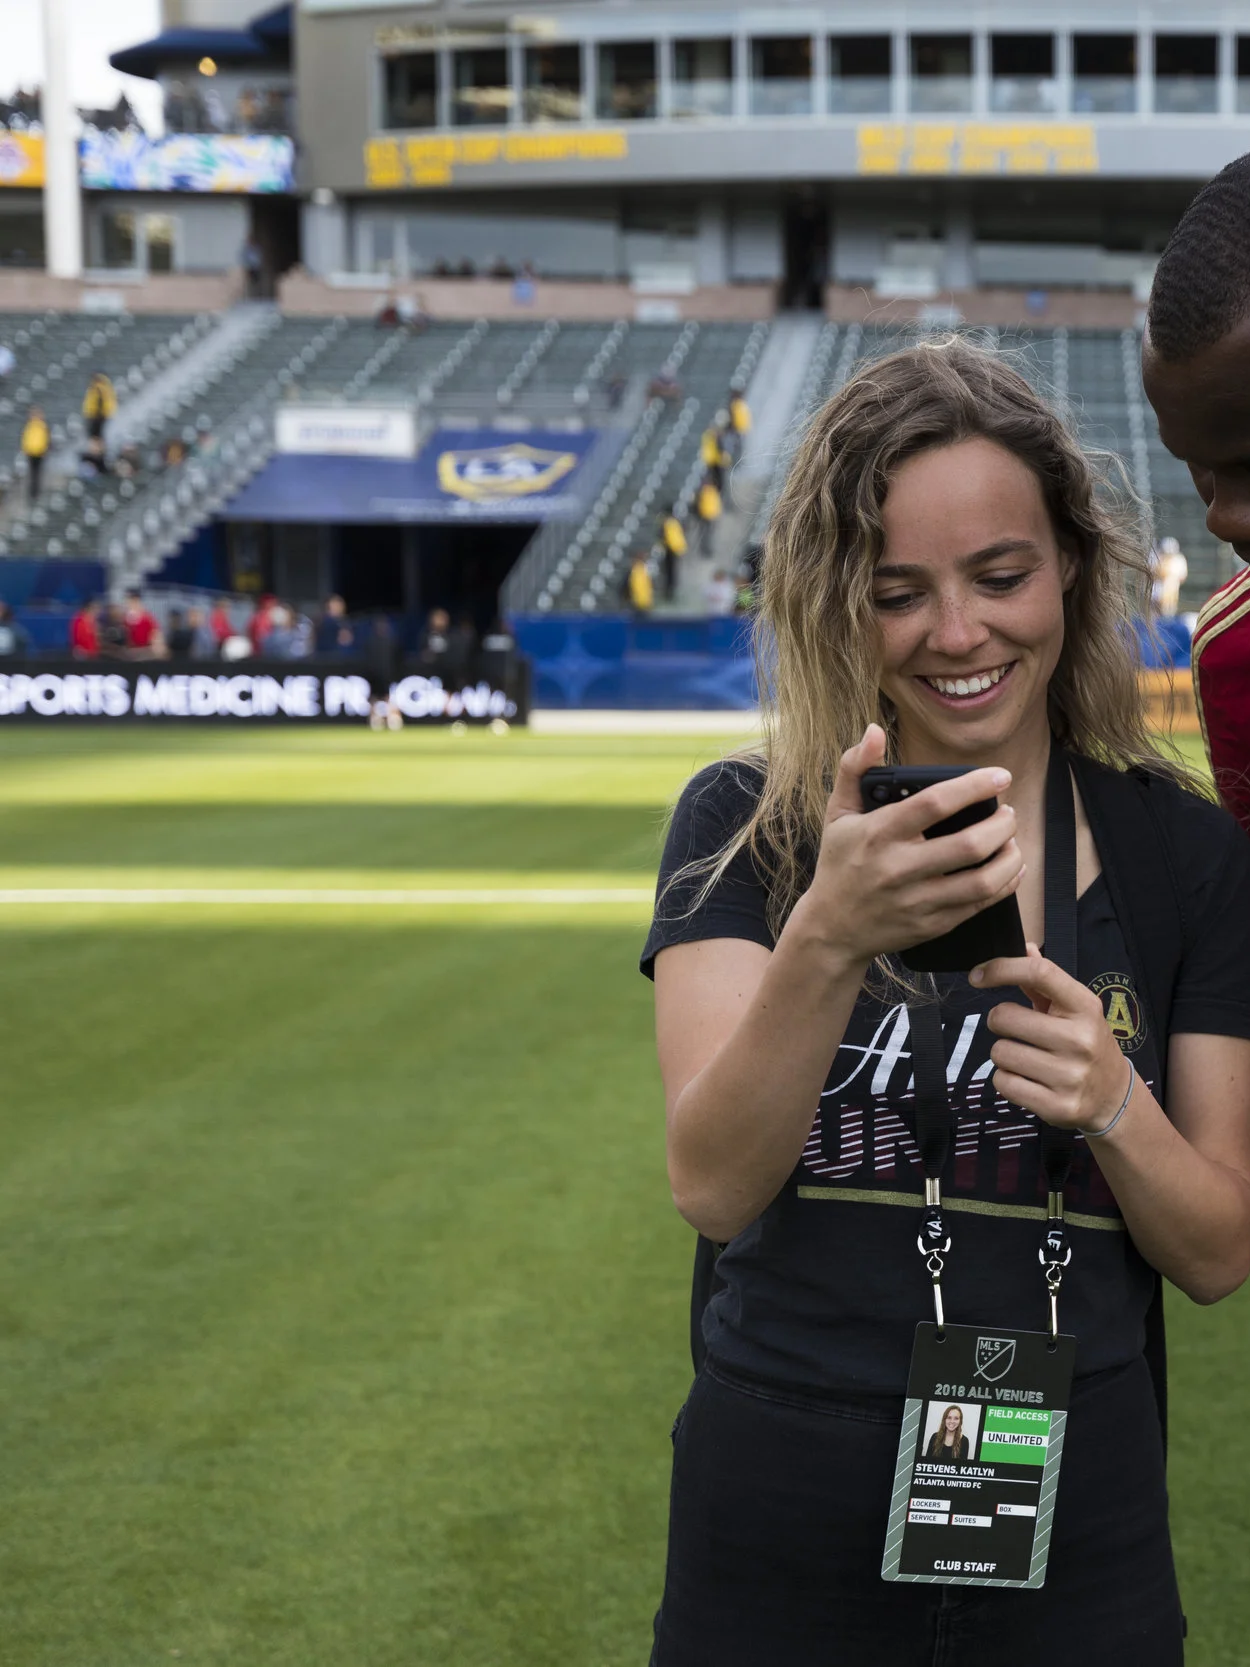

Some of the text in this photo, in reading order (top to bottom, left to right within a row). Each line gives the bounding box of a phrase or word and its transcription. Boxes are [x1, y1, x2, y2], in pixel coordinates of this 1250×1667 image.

[133, 674, 321, 717] MEDICINE
[1092, 975, 1136, 997] ATLAN
[980, 1340, 1001, 1351] MLS
[934, 1383, 1044, 1403] 2018 ALL VENUES
[988, 1408, 1049, 1421] FIELD ACCESS
[988, 1433, 1043, 1446] UNLIMITED
[915, 1463, 995, 1476] STEVENS, KATLYN
[913, 1478, 945, 1486] ATLANTA
[946, 1480, 971, 1488] UNITED
[933, 1560, 996, 1573] CLUB STAFF
